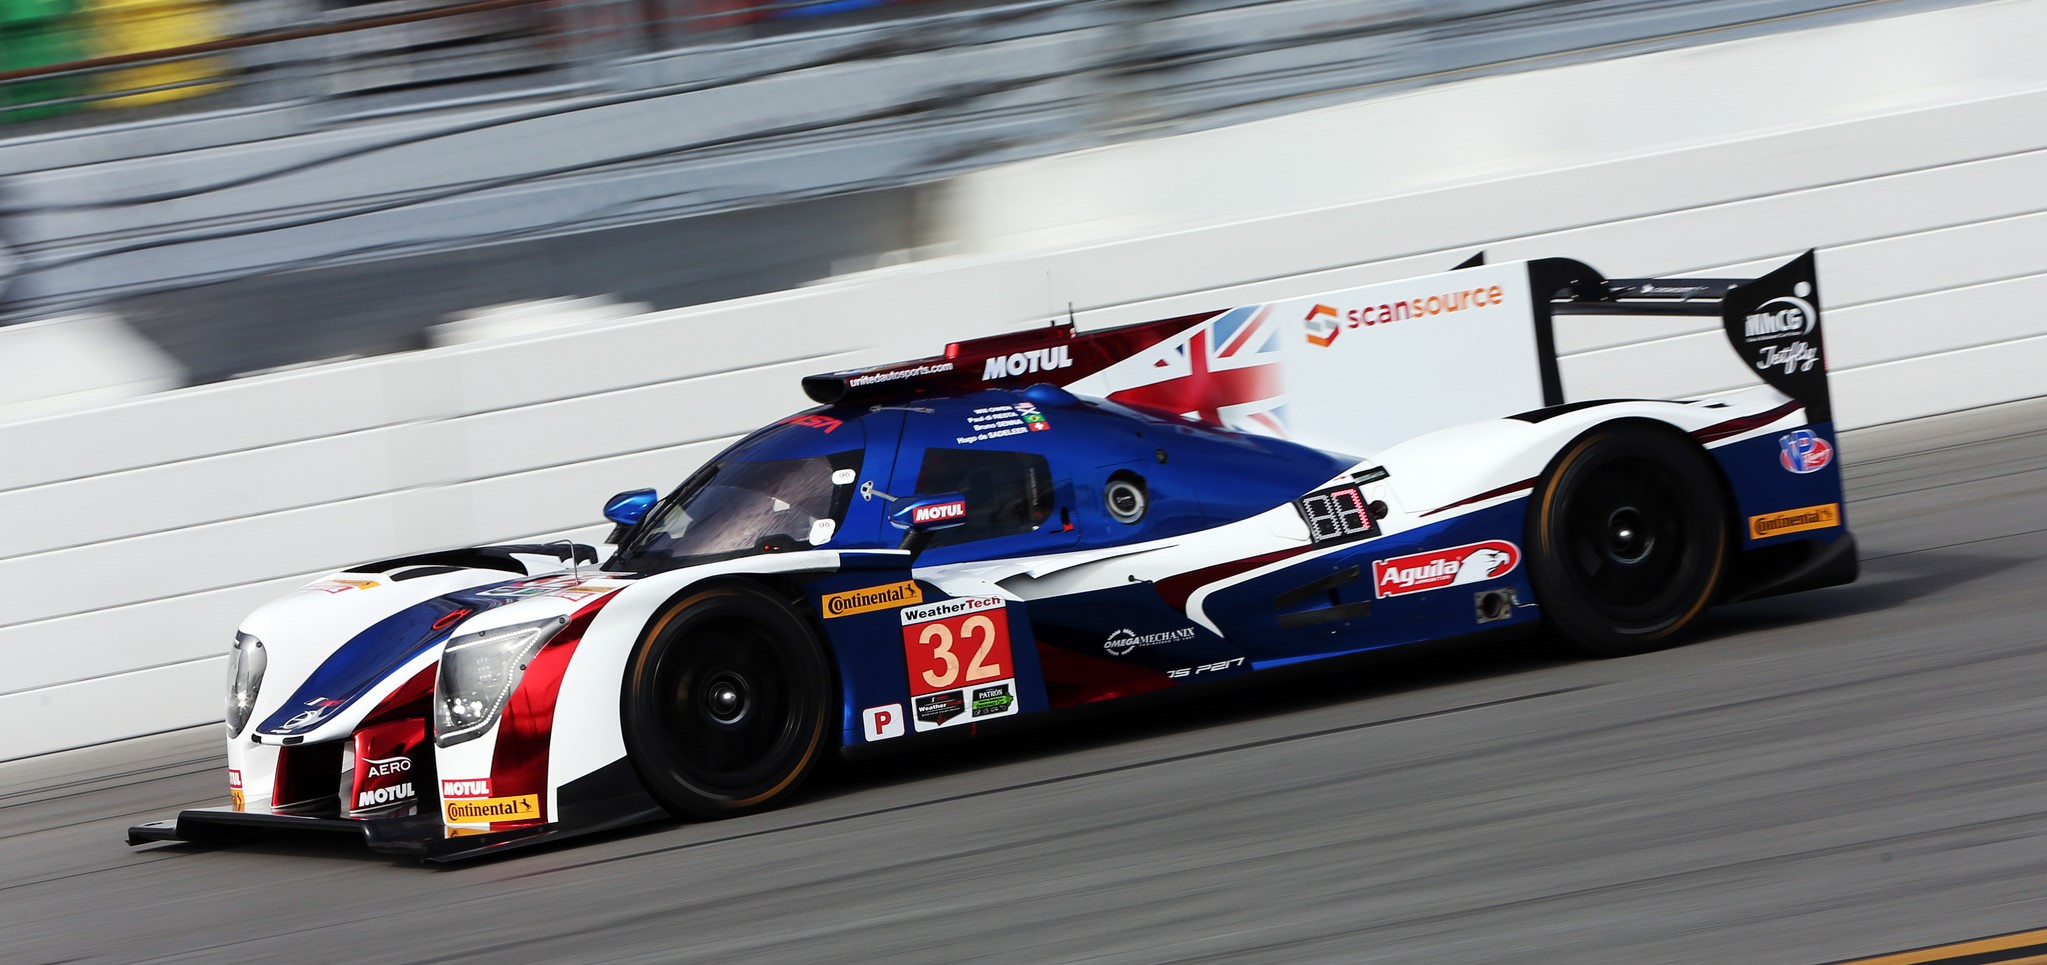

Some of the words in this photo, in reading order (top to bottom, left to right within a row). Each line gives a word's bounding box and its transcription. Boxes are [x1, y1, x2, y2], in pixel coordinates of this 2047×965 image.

[1347, 284, 1504, 329] scansource
[849, 361, 954, 388] unitedautosports.com
[981, 345, 1073, 382] MOTUL
[915, 503, 964, 521] MOTUL
[1380, 559, 1458, 588] Aguila
[828, 585, 905, 615] Continental
[905, 596, 1001, 621] WeatherTech
[918, 615, 1001, 688] 32
[874, 710, 892, 735] P
[368, 760, 411, 778] AERO
[358, 782, 416, 807] MOTUL
[443, 780, 490, 796] MOTUL
[447, 799, 519, 821] Continental
